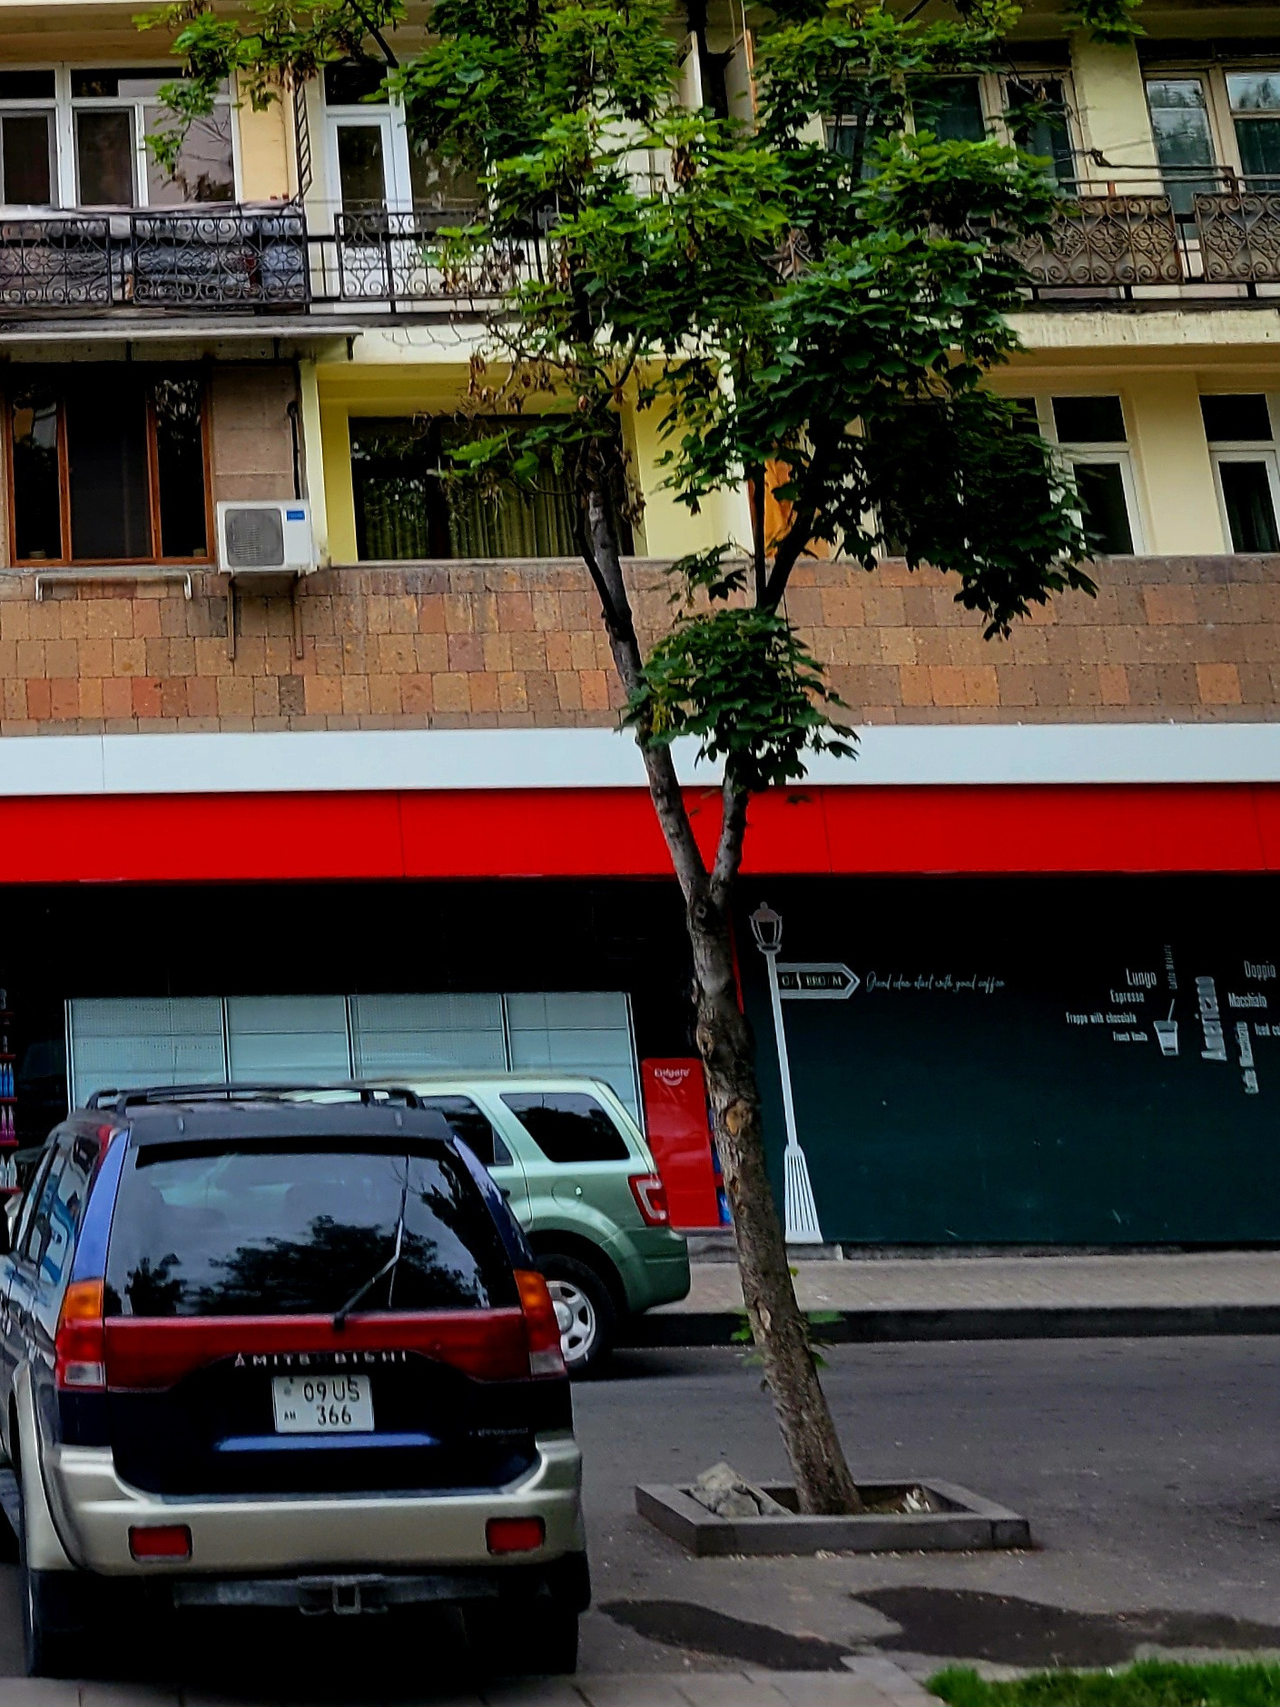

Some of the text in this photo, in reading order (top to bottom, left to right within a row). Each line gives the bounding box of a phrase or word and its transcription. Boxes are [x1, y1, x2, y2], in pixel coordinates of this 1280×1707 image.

[1125, 968, 1157, 989] Lungo
[1244, 960, 1276, 981] Doppio
[952, 973, 976, 993] good
[978, 975, 1005, 994] coffee
[1109, 988, 1145, 1005] Espresso
[1089, 1012, 1104, 1024] with
[1106, 1012, 1137, 1024] chocolate
[252, 1349, 407, 1367] MITSBISHI
[316, 1404, 353, 1426] 366
